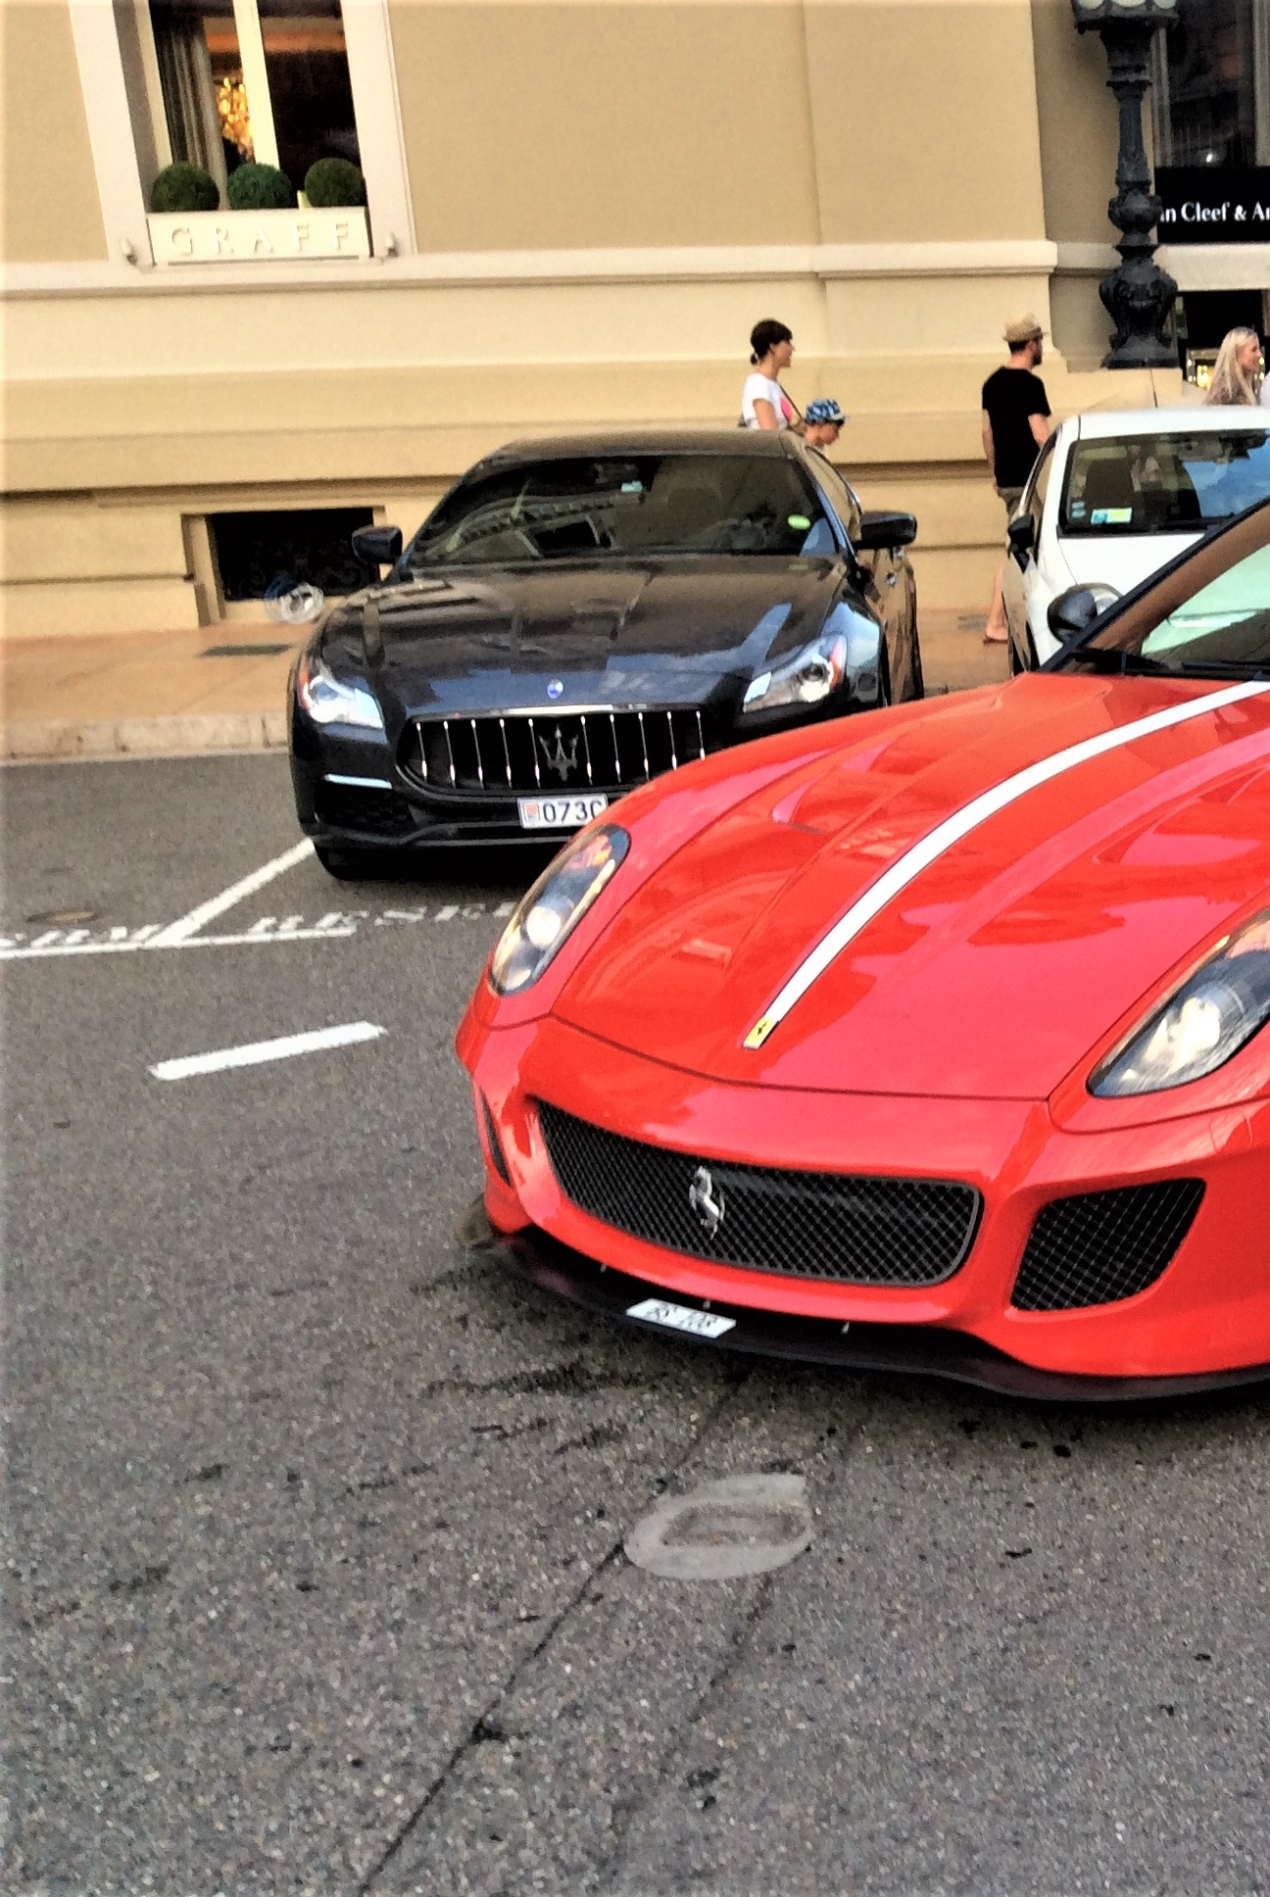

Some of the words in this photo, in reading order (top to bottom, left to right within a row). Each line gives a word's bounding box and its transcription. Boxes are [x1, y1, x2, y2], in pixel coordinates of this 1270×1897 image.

[1160, 206, 1177, 223] an
[1181, 201, 1231, 223] Cleef
[1233, 204, 1247, 222] &
[170, 220, 349, 256] GRAFF
